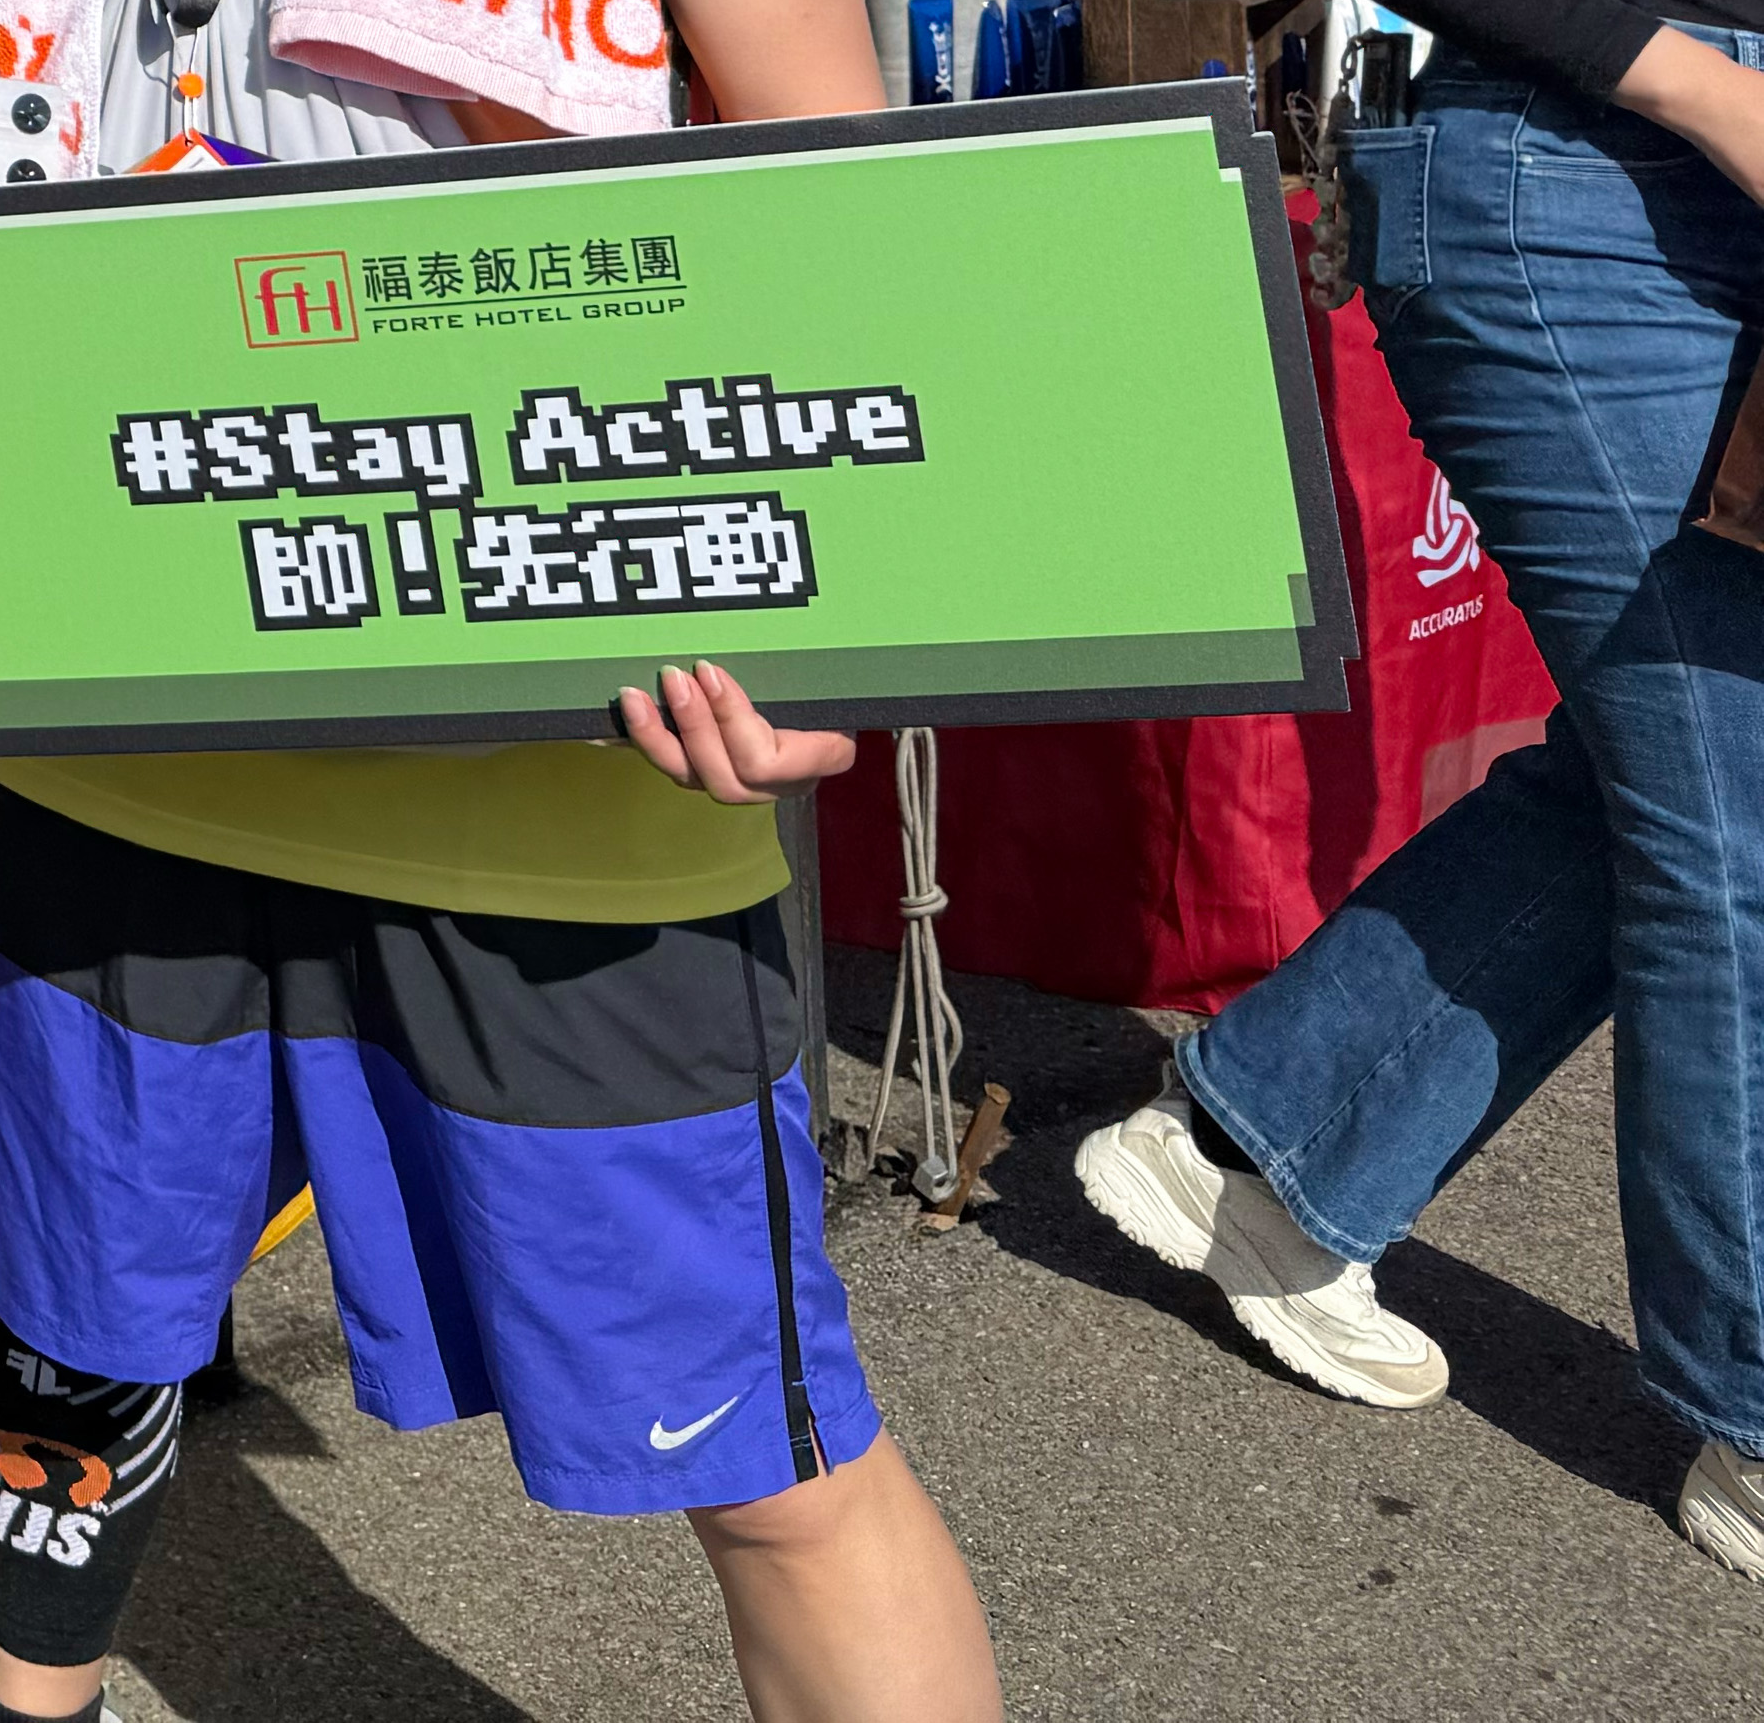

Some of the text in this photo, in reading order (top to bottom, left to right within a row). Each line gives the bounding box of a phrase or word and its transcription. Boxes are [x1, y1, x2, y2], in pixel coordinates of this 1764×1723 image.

[362, 234, 682, 303] 福泰飯店集團
[372, 297, 686, 334] FORTE HOTEL GROUP
[112, 373, 926, 507] #Stay Active
[1408, 593, 1485, 642] ACCURATUS
